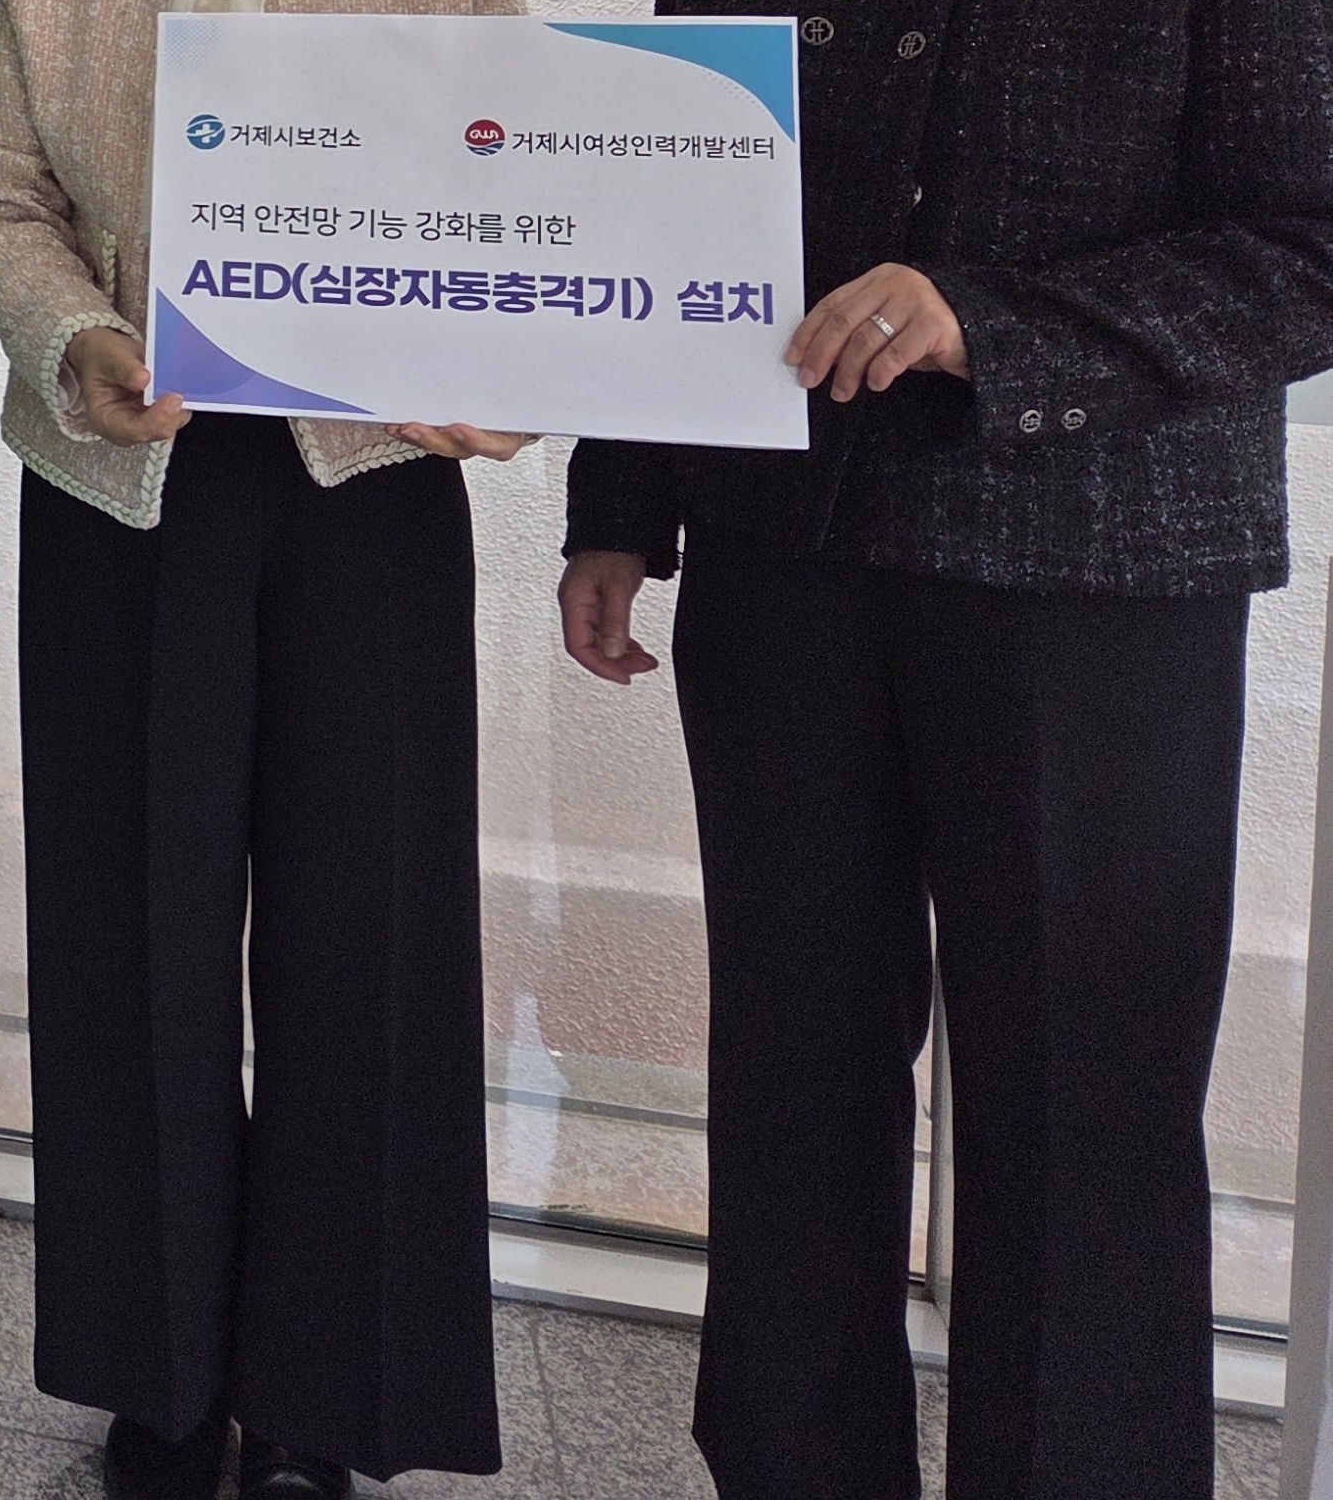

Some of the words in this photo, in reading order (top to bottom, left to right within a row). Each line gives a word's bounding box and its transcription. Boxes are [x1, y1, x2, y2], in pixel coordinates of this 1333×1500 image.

[229, 123, 362, 150] 거제시보건소
[512, 130, 776, 161] 거제시여성인력개발센터
[189, 203, 245, 233] 지역
[254, 204, 341, 238] 안전망
[348, 206, 407, 243] 기능
[415, 211, 506, 244] 강화를
[513, 214, 577, 246] 위한
[181, 259, 655, 323] AED(심장자동충격기)
[676, 280, 774, 325] 설치
